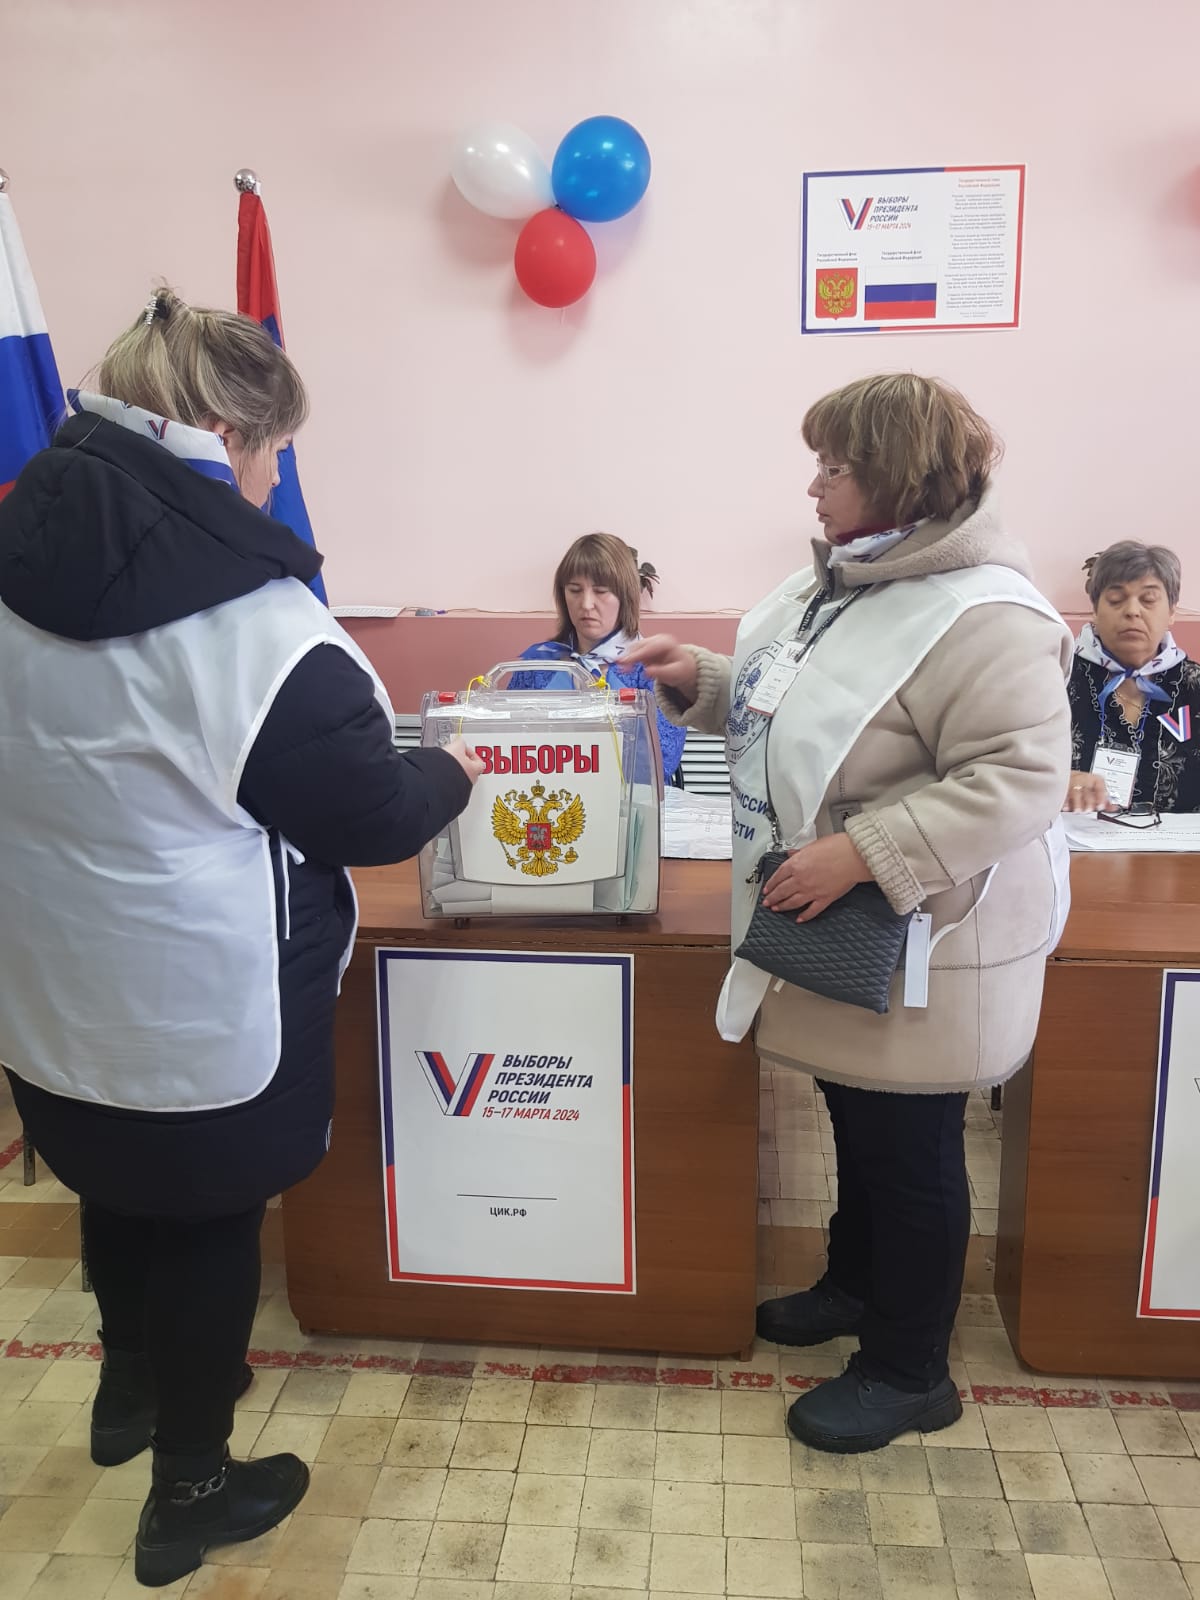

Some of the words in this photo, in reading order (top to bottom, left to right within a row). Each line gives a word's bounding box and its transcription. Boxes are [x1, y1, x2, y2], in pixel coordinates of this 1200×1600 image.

[877, 196, 910, 204] ВЫБОРЫ
[873, 204, 919, 213] ПРЕЗИДЕНТА
[869, 214, 899, 222] РОССИИ
[474, 744, 600, 775] ВЫБОРЫ
[502, 1054, 573, 1070] ВЫБОРЫ
[494, 1072, 594, 1089] ПРЕЗИДЕНТА
[487, 1090, 552, 1105] РОССИИ
[513, 1107, 551, 1121] МАРТА
[552, 1109, 580, 1121] 2024
[489, 1206, 527, 1217] ЦИК.РФ
